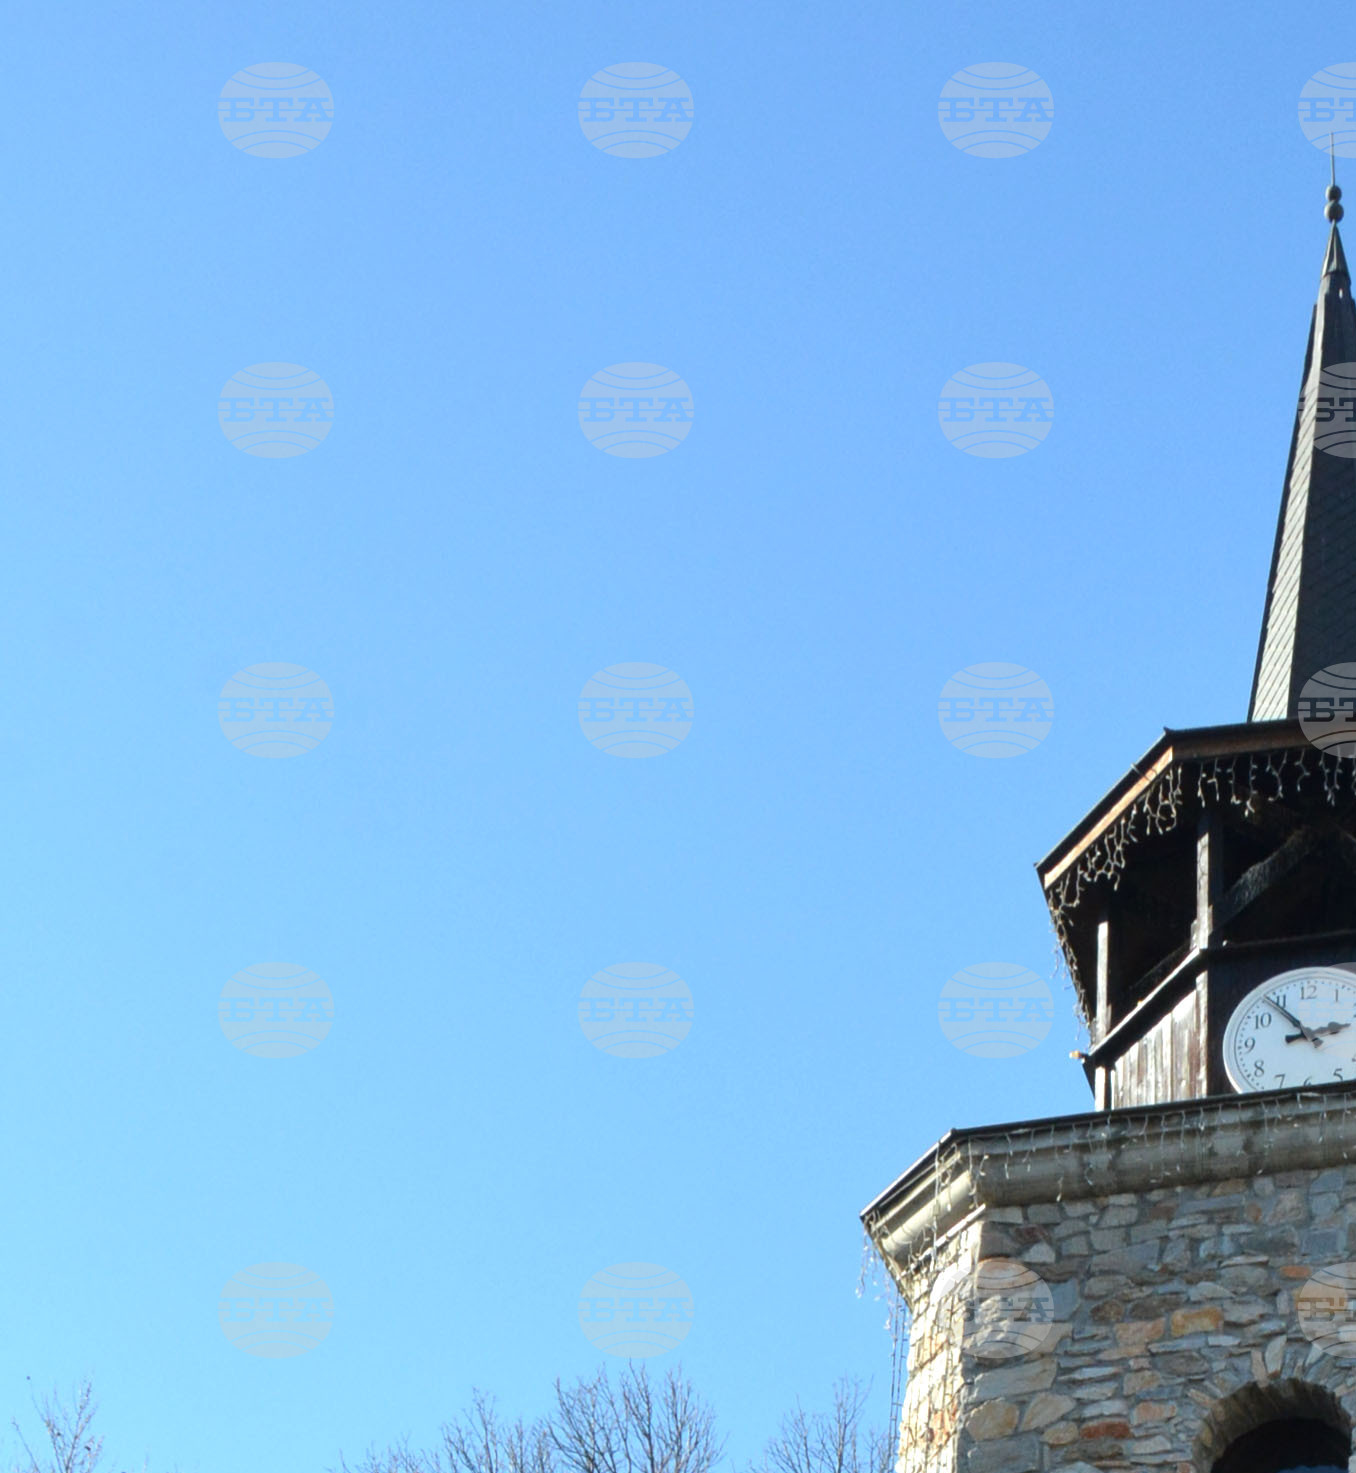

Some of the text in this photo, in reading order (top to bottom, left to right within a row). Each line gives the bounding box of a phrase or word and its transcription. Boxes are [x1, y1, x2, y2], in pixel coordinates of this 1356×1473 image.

[1300, 985, 1317, 1000] 12
[1253, 1012, 1272, 1029] 10
[1244, 1037, 1256, 1054] 9
[1254, 1060, 1265, 1078] 8
[1333, 1068, 1344, 1081] 5
[1275, 1074, 1286, 1089] 7
